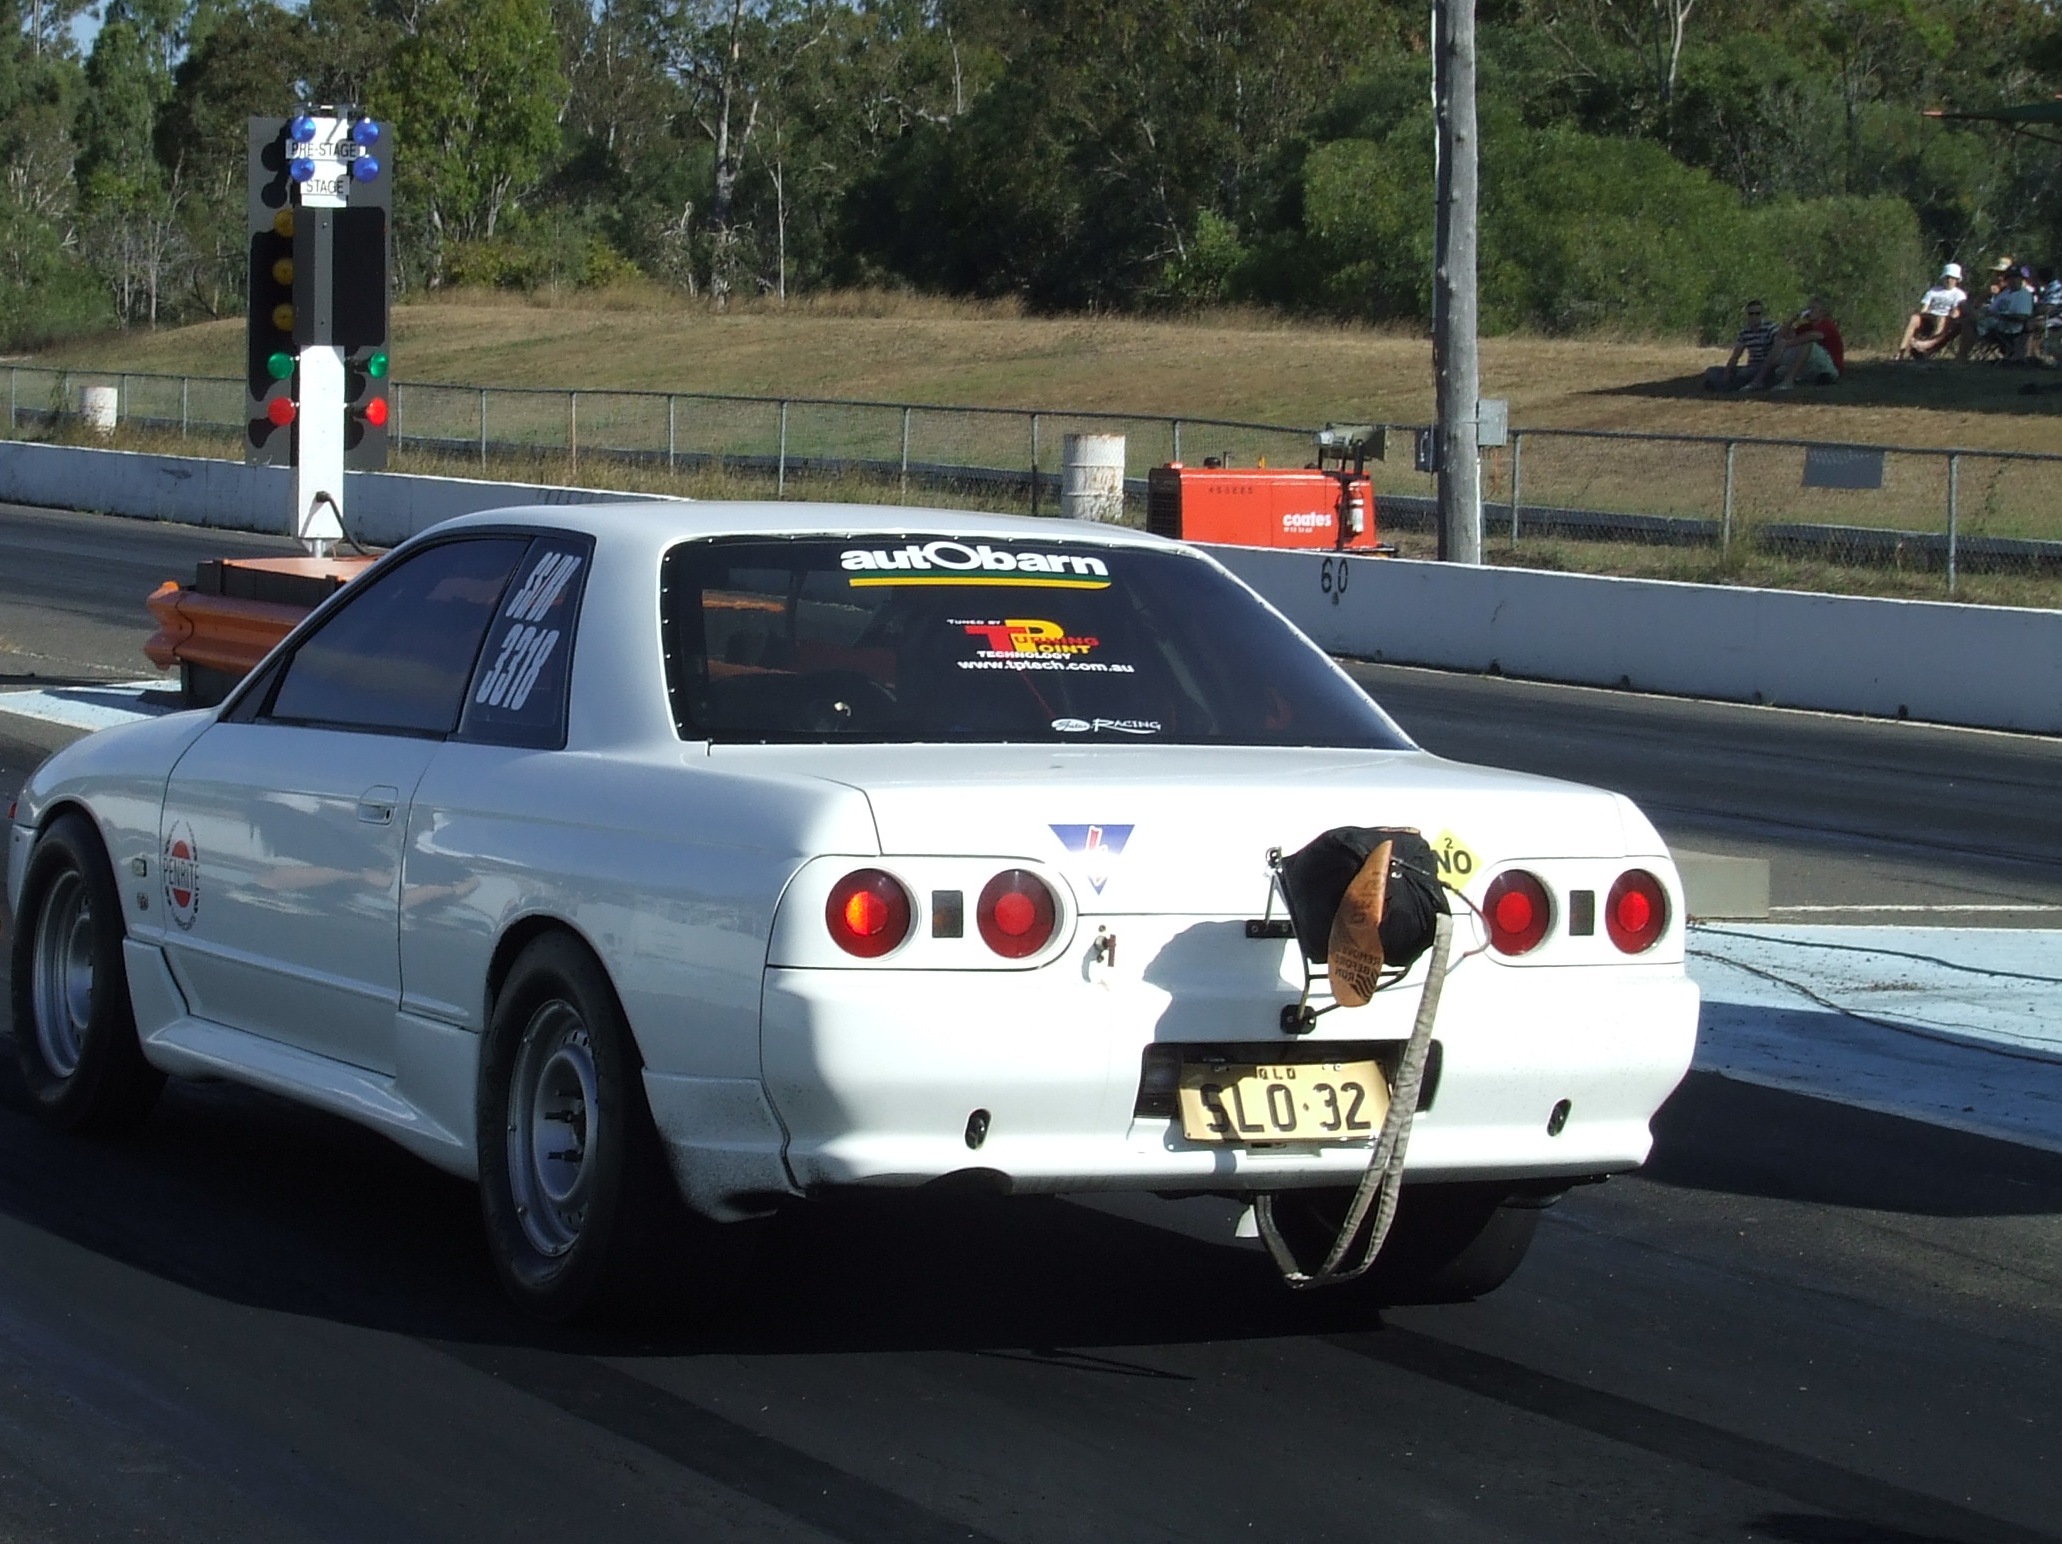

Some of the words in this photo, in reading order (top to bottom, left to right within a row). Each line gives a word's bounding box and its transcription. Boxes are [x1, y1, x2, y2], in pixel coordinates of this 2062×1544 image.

[291, 142, 357, 158] PRE-STAGE
[306, 180, 344, 195] STAGE
[1282, 512, 1332, 527] coates
[976, 650, 1071, 660] TECHNOLOGY
[475, 623, 560, 710] 3318
[957, 659, 1135, 673] www.tptech.com.au
[1092, 718, 1161, 734] RACING
[163, 857, 200, 892] PENRITE
[1258, 1067, 1296, 1080] QLD
